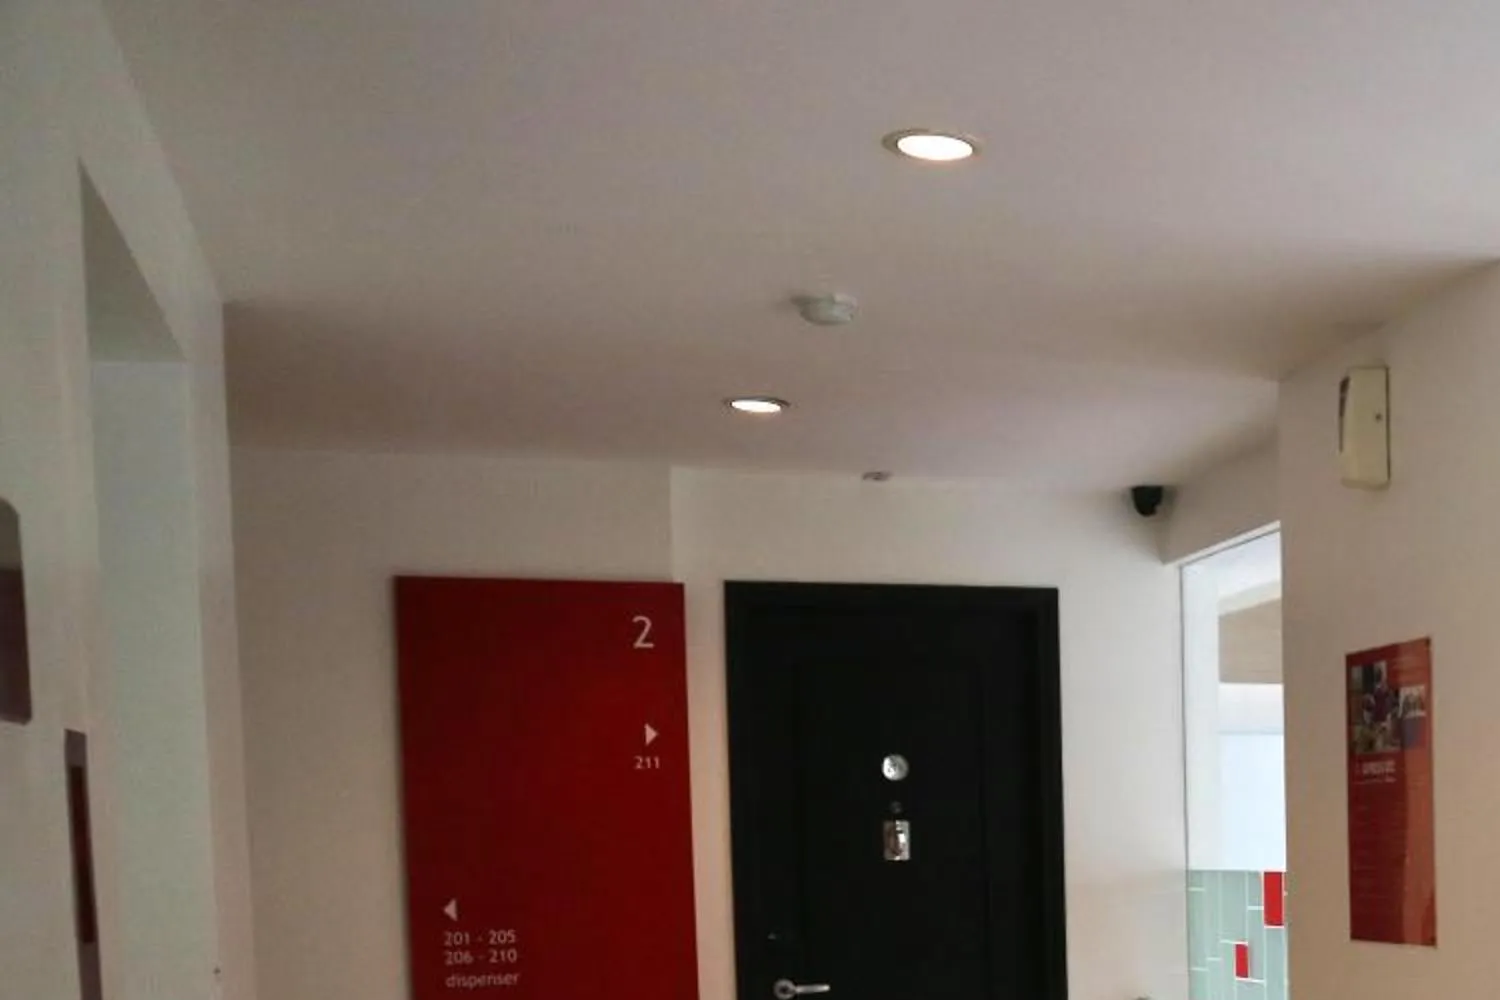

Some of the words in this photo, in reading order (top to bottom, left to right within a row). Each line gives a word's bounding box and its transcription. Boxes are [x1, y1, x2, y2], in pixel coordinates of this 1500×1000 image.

[632, 615, 655, 648] 2
[635, 756, 660, 769] 211
[444, 931, 470, 947] 201
[489, 929, 516, 945] 205
[445, 950, 473, 965] 206
[489, 949, 518, 963] 210
[445, 973, 520, 990] dispenser
